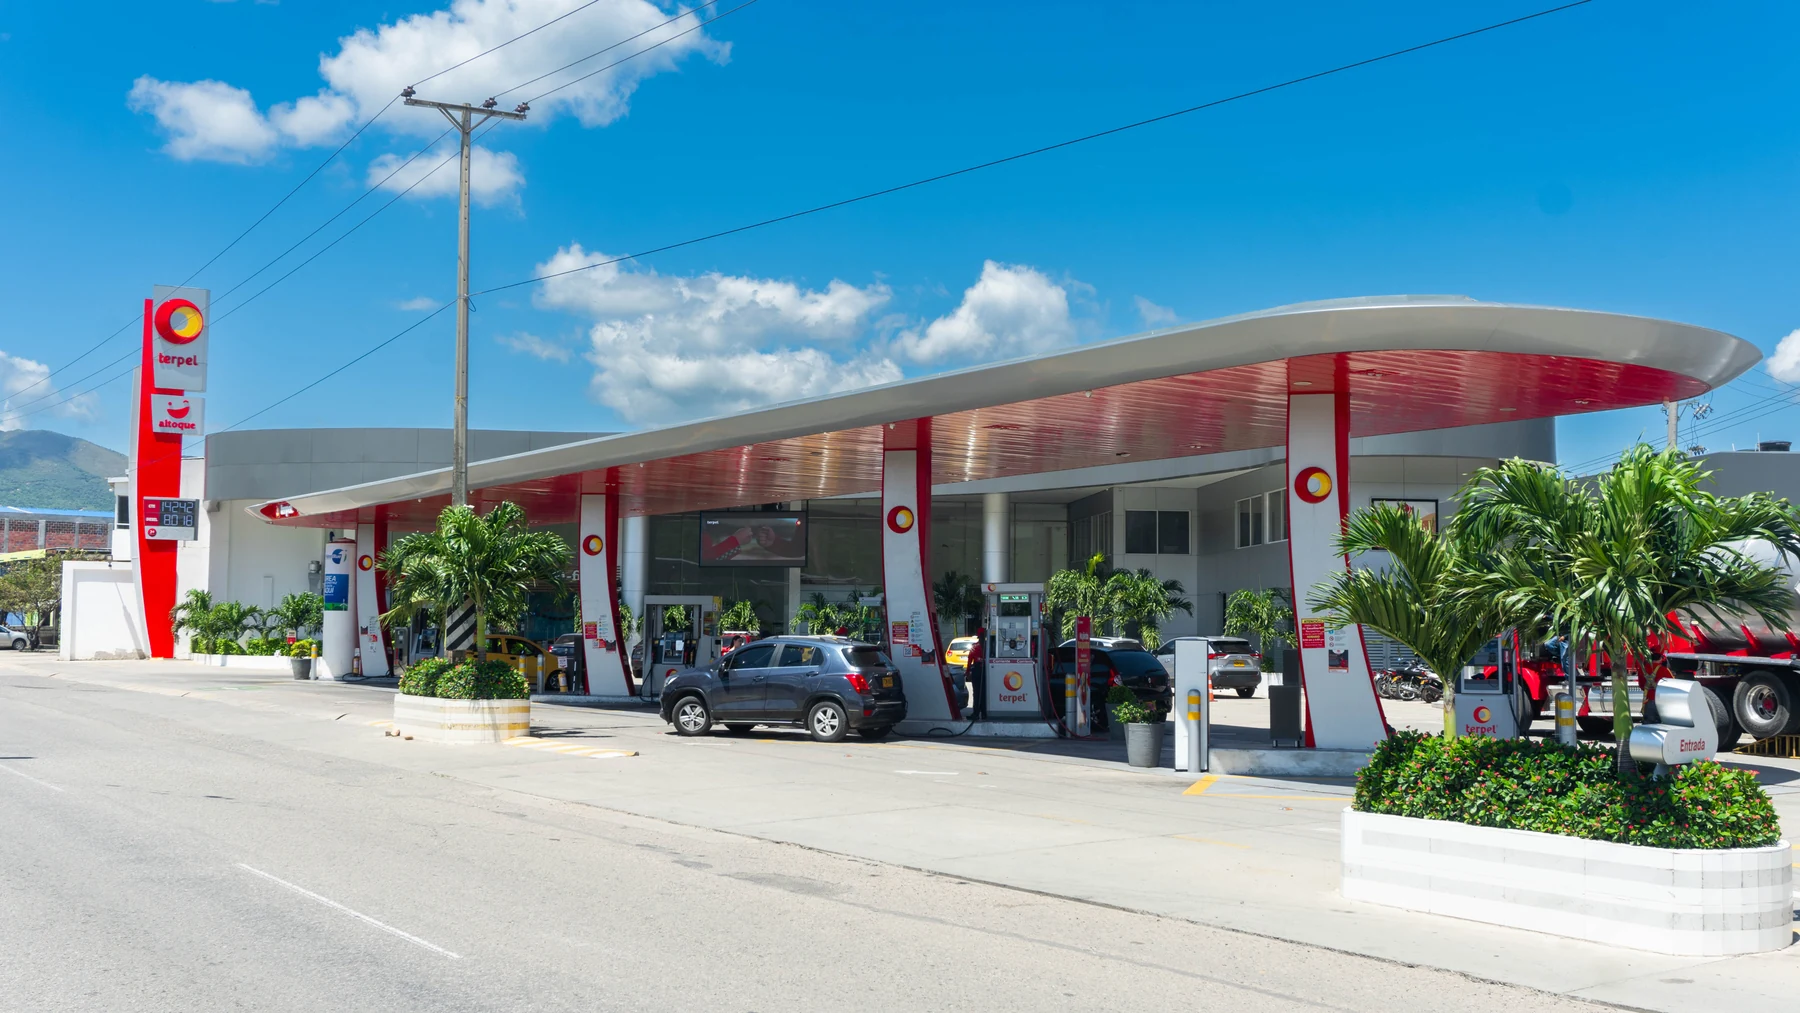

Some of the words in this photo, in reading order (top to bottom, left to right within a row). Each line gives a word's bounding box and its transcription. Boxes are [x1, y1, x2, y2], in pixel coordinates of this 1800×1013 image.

[158, 352, 198, 367] terpel
[159, 420, 196, 430] altoque
[162, 501, 194, 513] 14242
[999, 693, 1026, 704] terpel
[1465, 724, 1496, 735] terpel
[1680, 738, 1706, 752] Entrada
